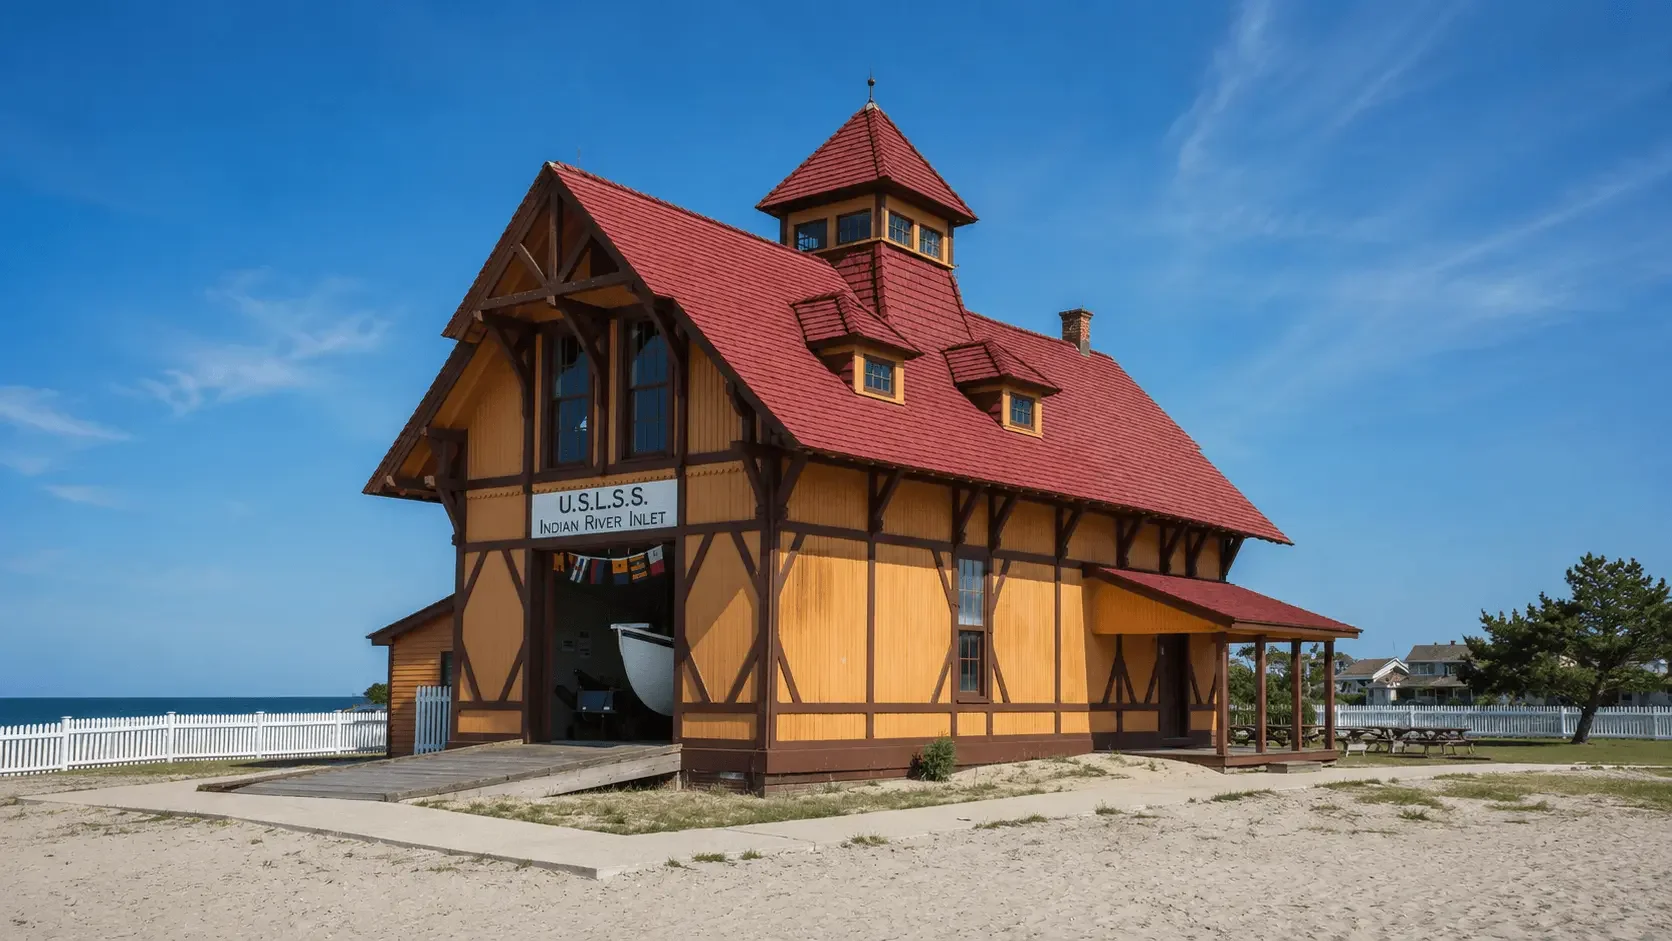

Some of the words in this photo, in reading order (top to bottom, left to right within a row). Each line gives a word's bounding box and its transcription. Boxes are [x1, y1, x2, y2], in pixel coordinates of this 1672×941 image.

[559, 486, 648, 514] U.S.L.S.S.
[540, 519, 579, 535] INDIAN
[585, 514, 622, 531] RIVER
[629, 510, 667, 527] INLET
